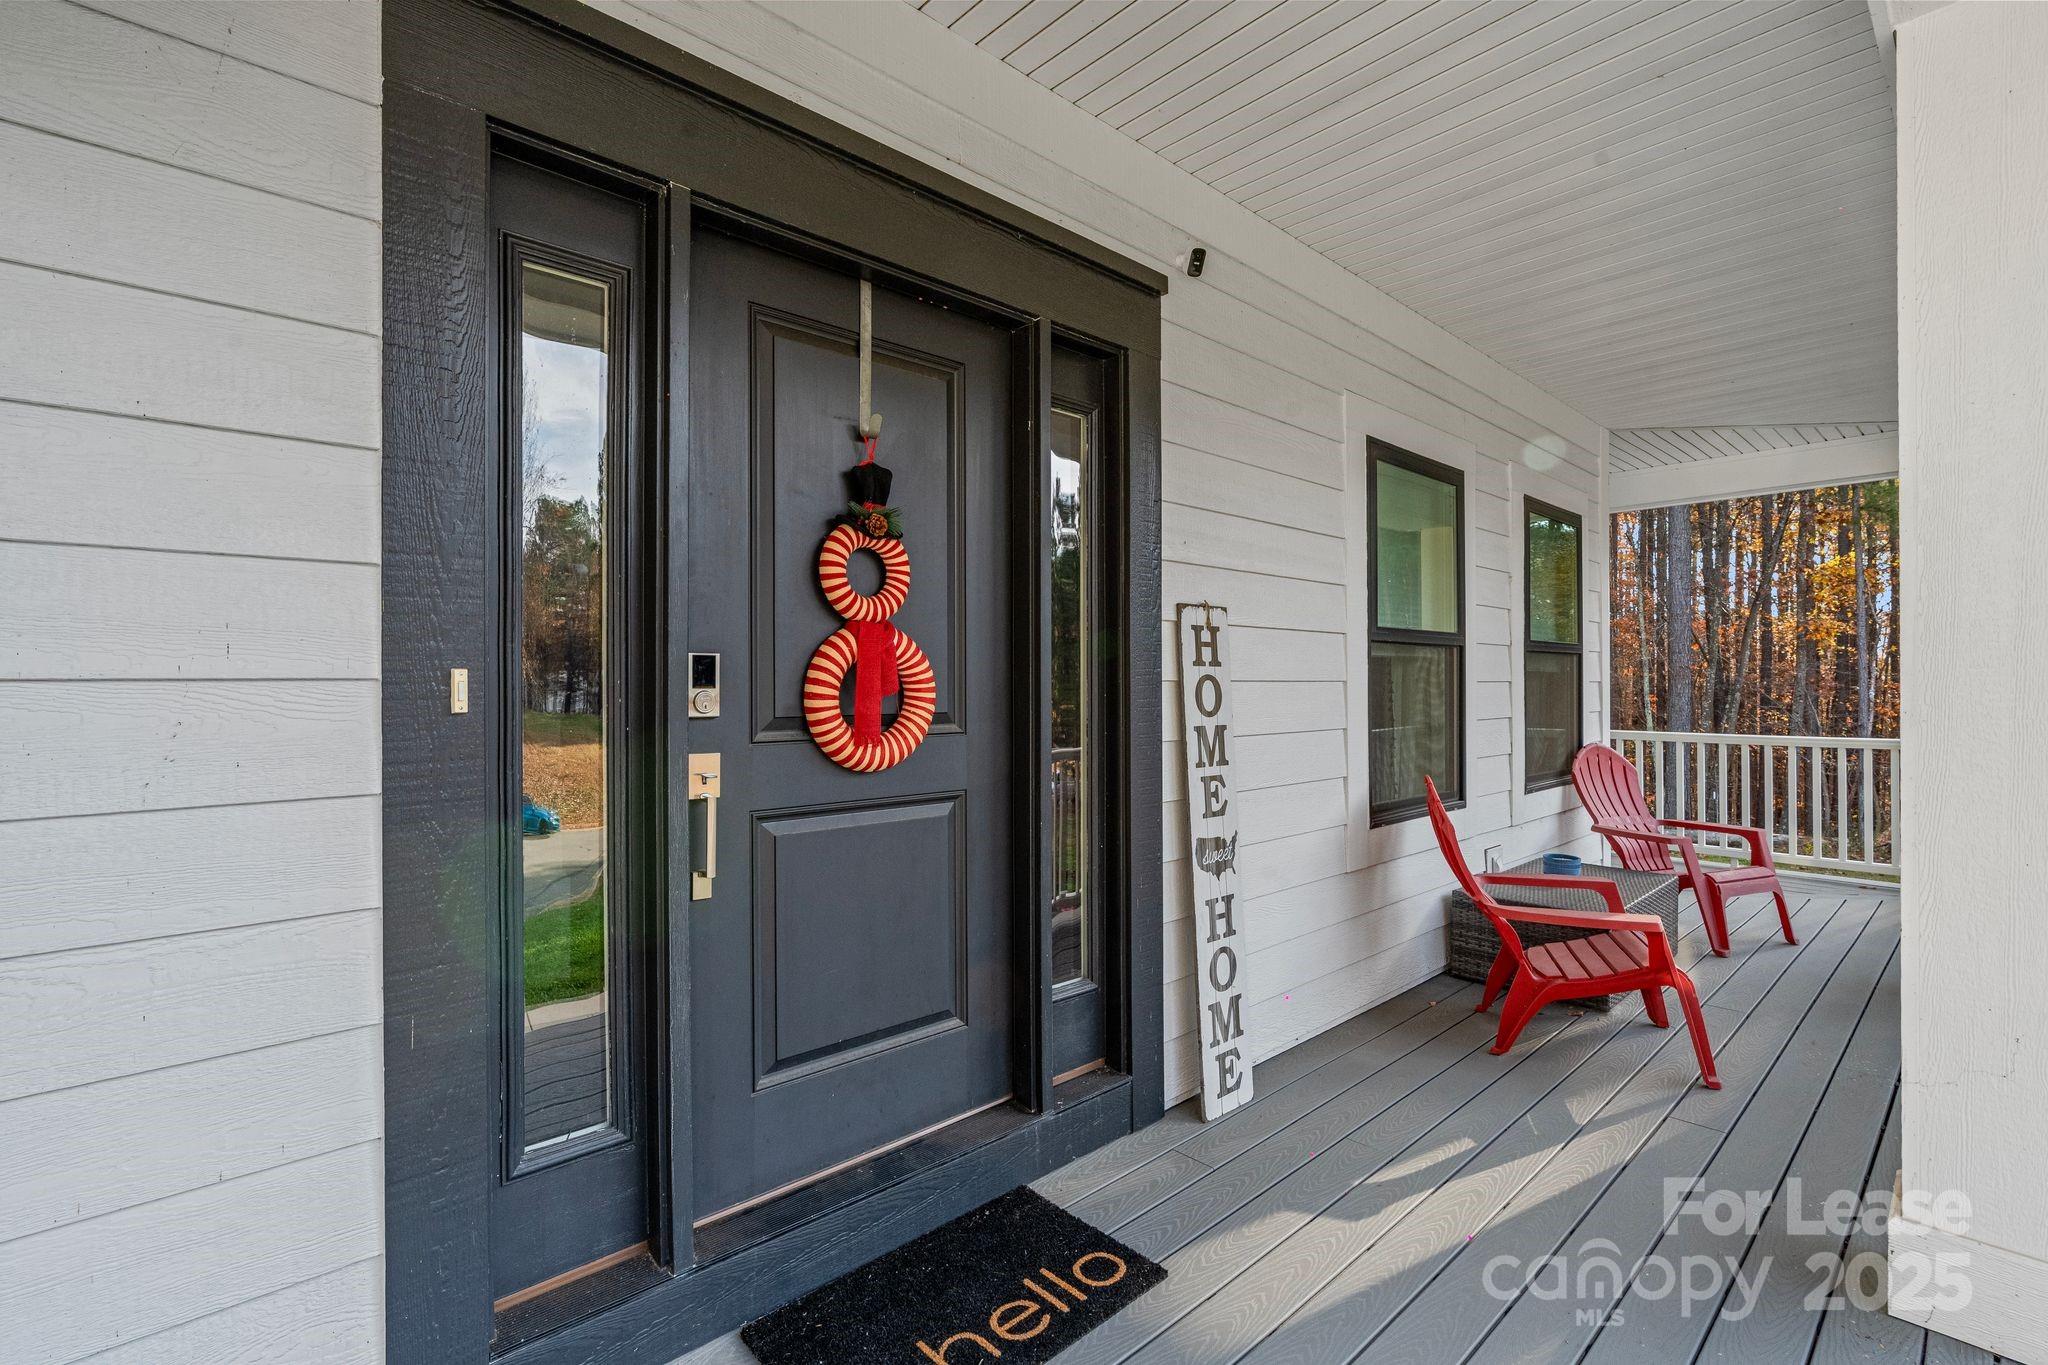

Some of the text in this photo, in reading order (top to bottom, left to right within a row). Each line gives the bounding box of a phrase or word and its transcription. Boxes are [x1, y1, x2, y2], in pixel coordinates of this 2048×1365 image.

[1191, 623, 1230, 820] HOME
[1202, 845, 1234, 865] sweet
[1204, 892, 1244, 1100] HOME
[915, 1251, 1128, 1365] hello
